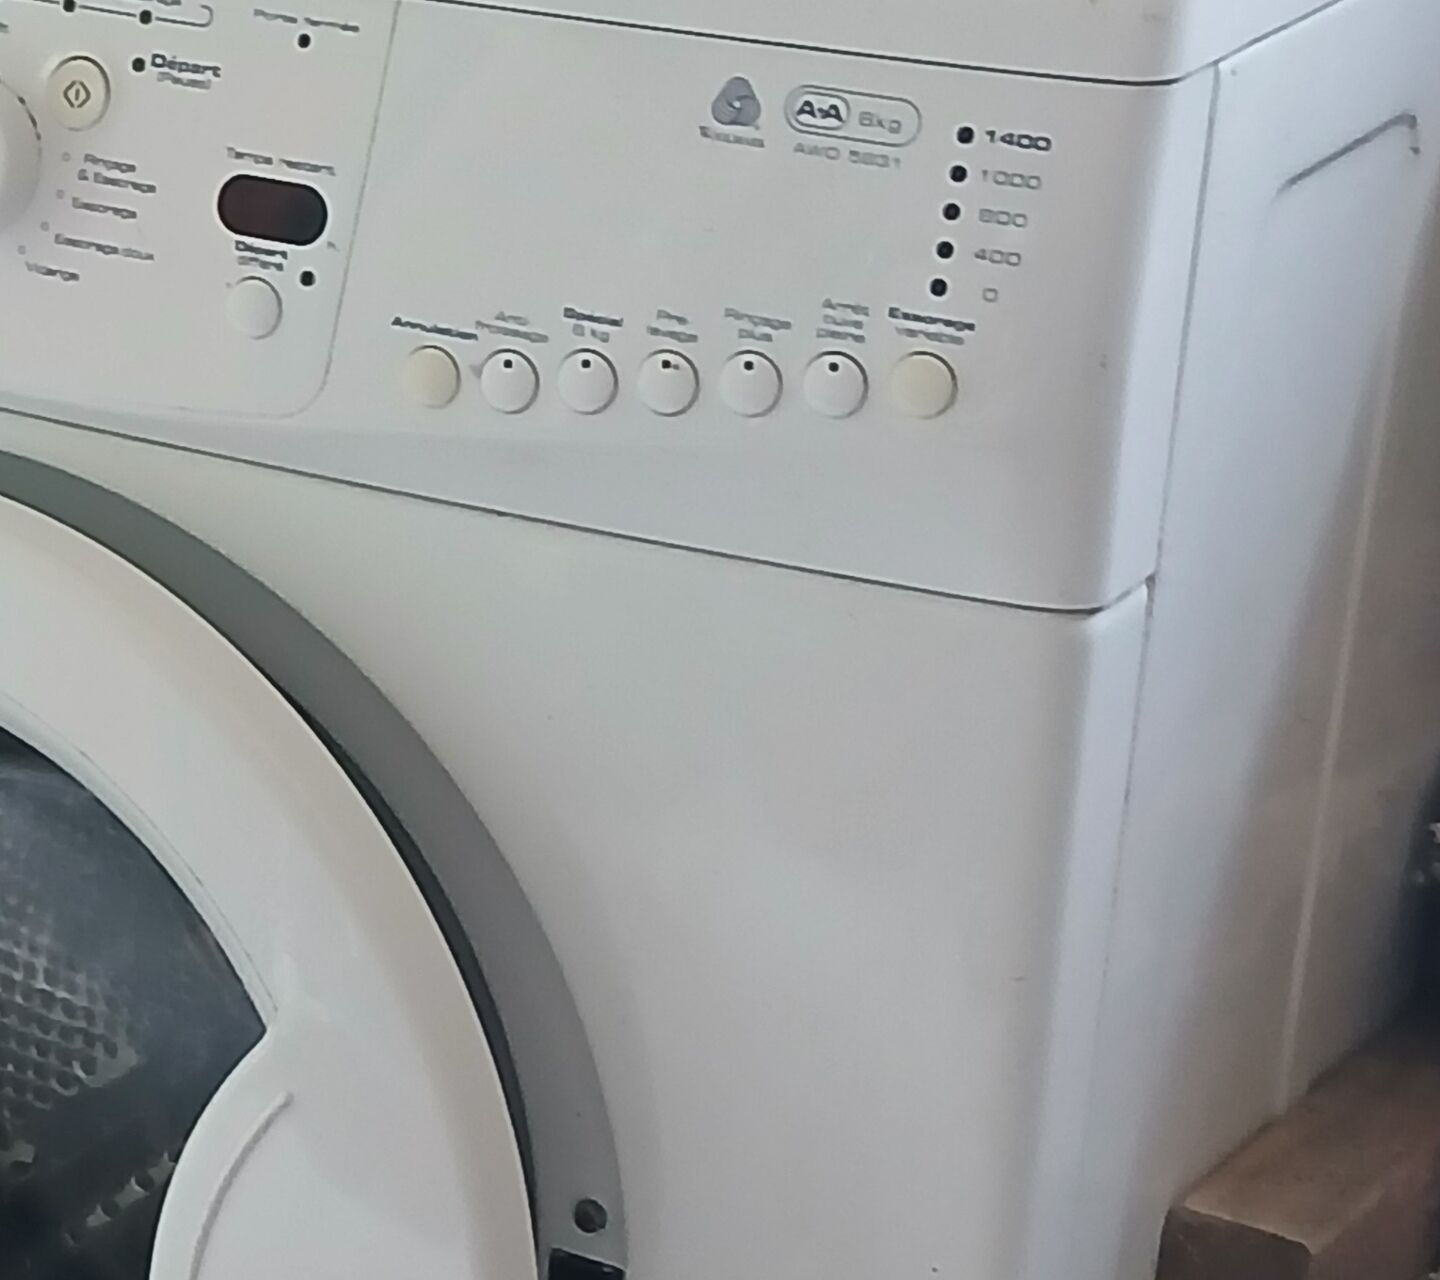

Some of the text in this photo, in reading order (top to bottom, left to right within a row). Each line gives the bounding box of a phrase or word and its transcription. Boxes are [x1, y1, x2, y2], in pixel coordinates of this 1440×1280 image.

[985, 130, 1052, 151] 1400
[982, 169, 1041, 190] 1000
[974, 248, 1022, 267] 400
